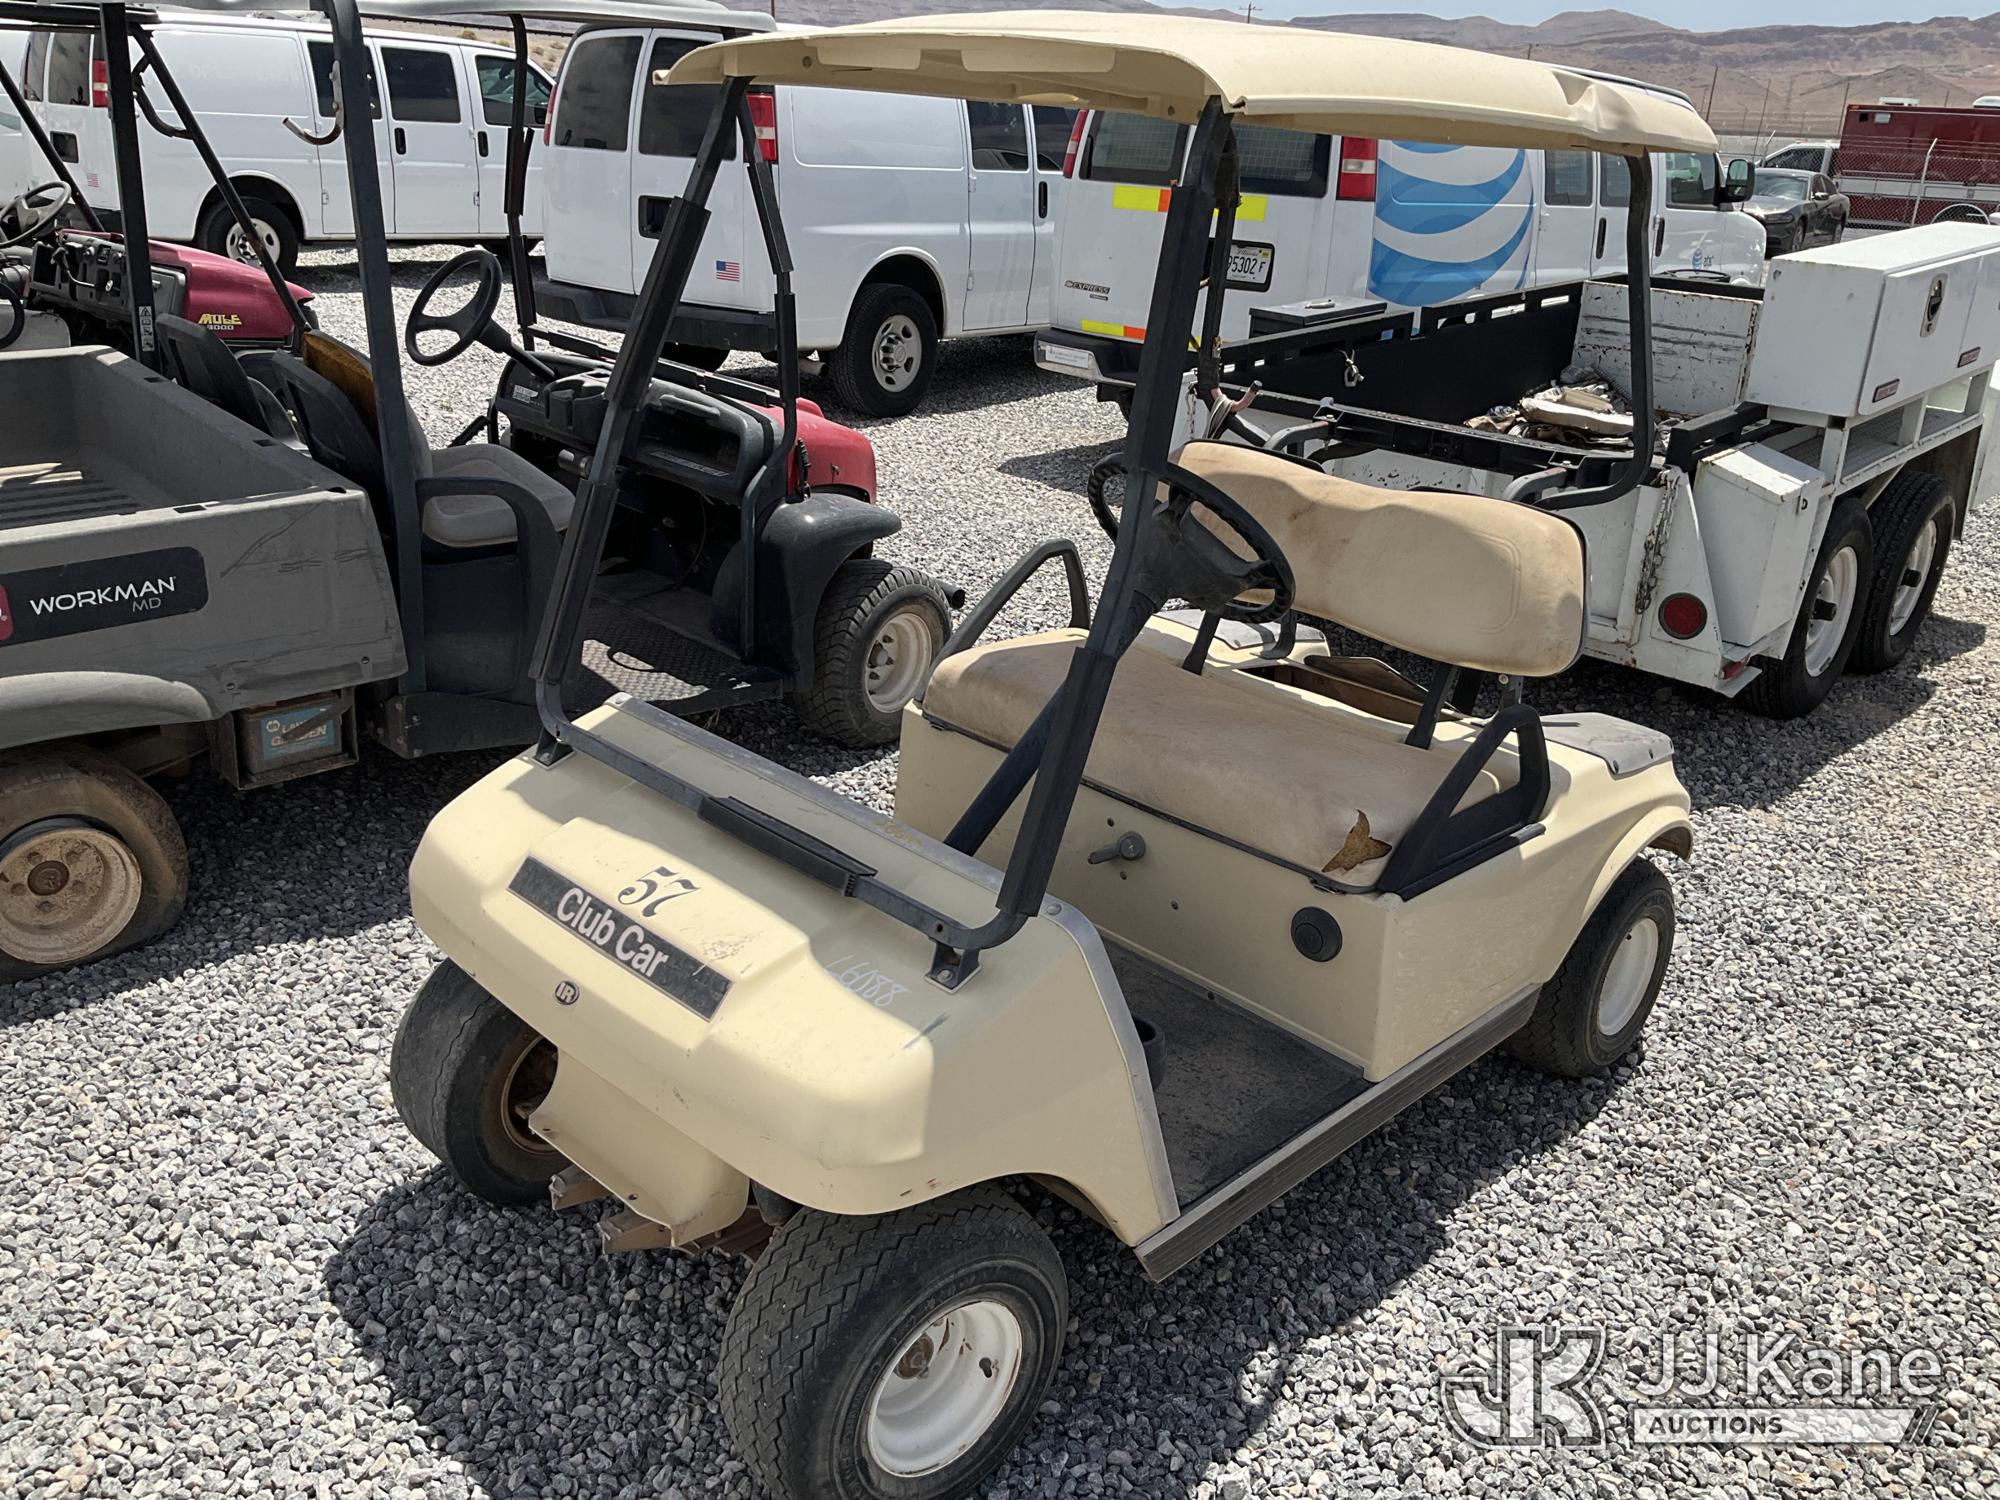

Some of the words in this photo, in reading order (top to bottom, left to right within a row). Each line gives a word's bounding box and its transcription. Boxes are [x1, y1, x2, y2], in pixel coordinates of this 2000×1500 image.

[198, 313, 243, 325] MULE
[30, 577, 175, 615] WORKMAN
[132, 597, 162, 613] MD
[618, 866, 701, 918] 57
[556, 887, 616, 946] Club
[615, 924, 669, 978] Car
[558, 982, 577, 1003] IR
